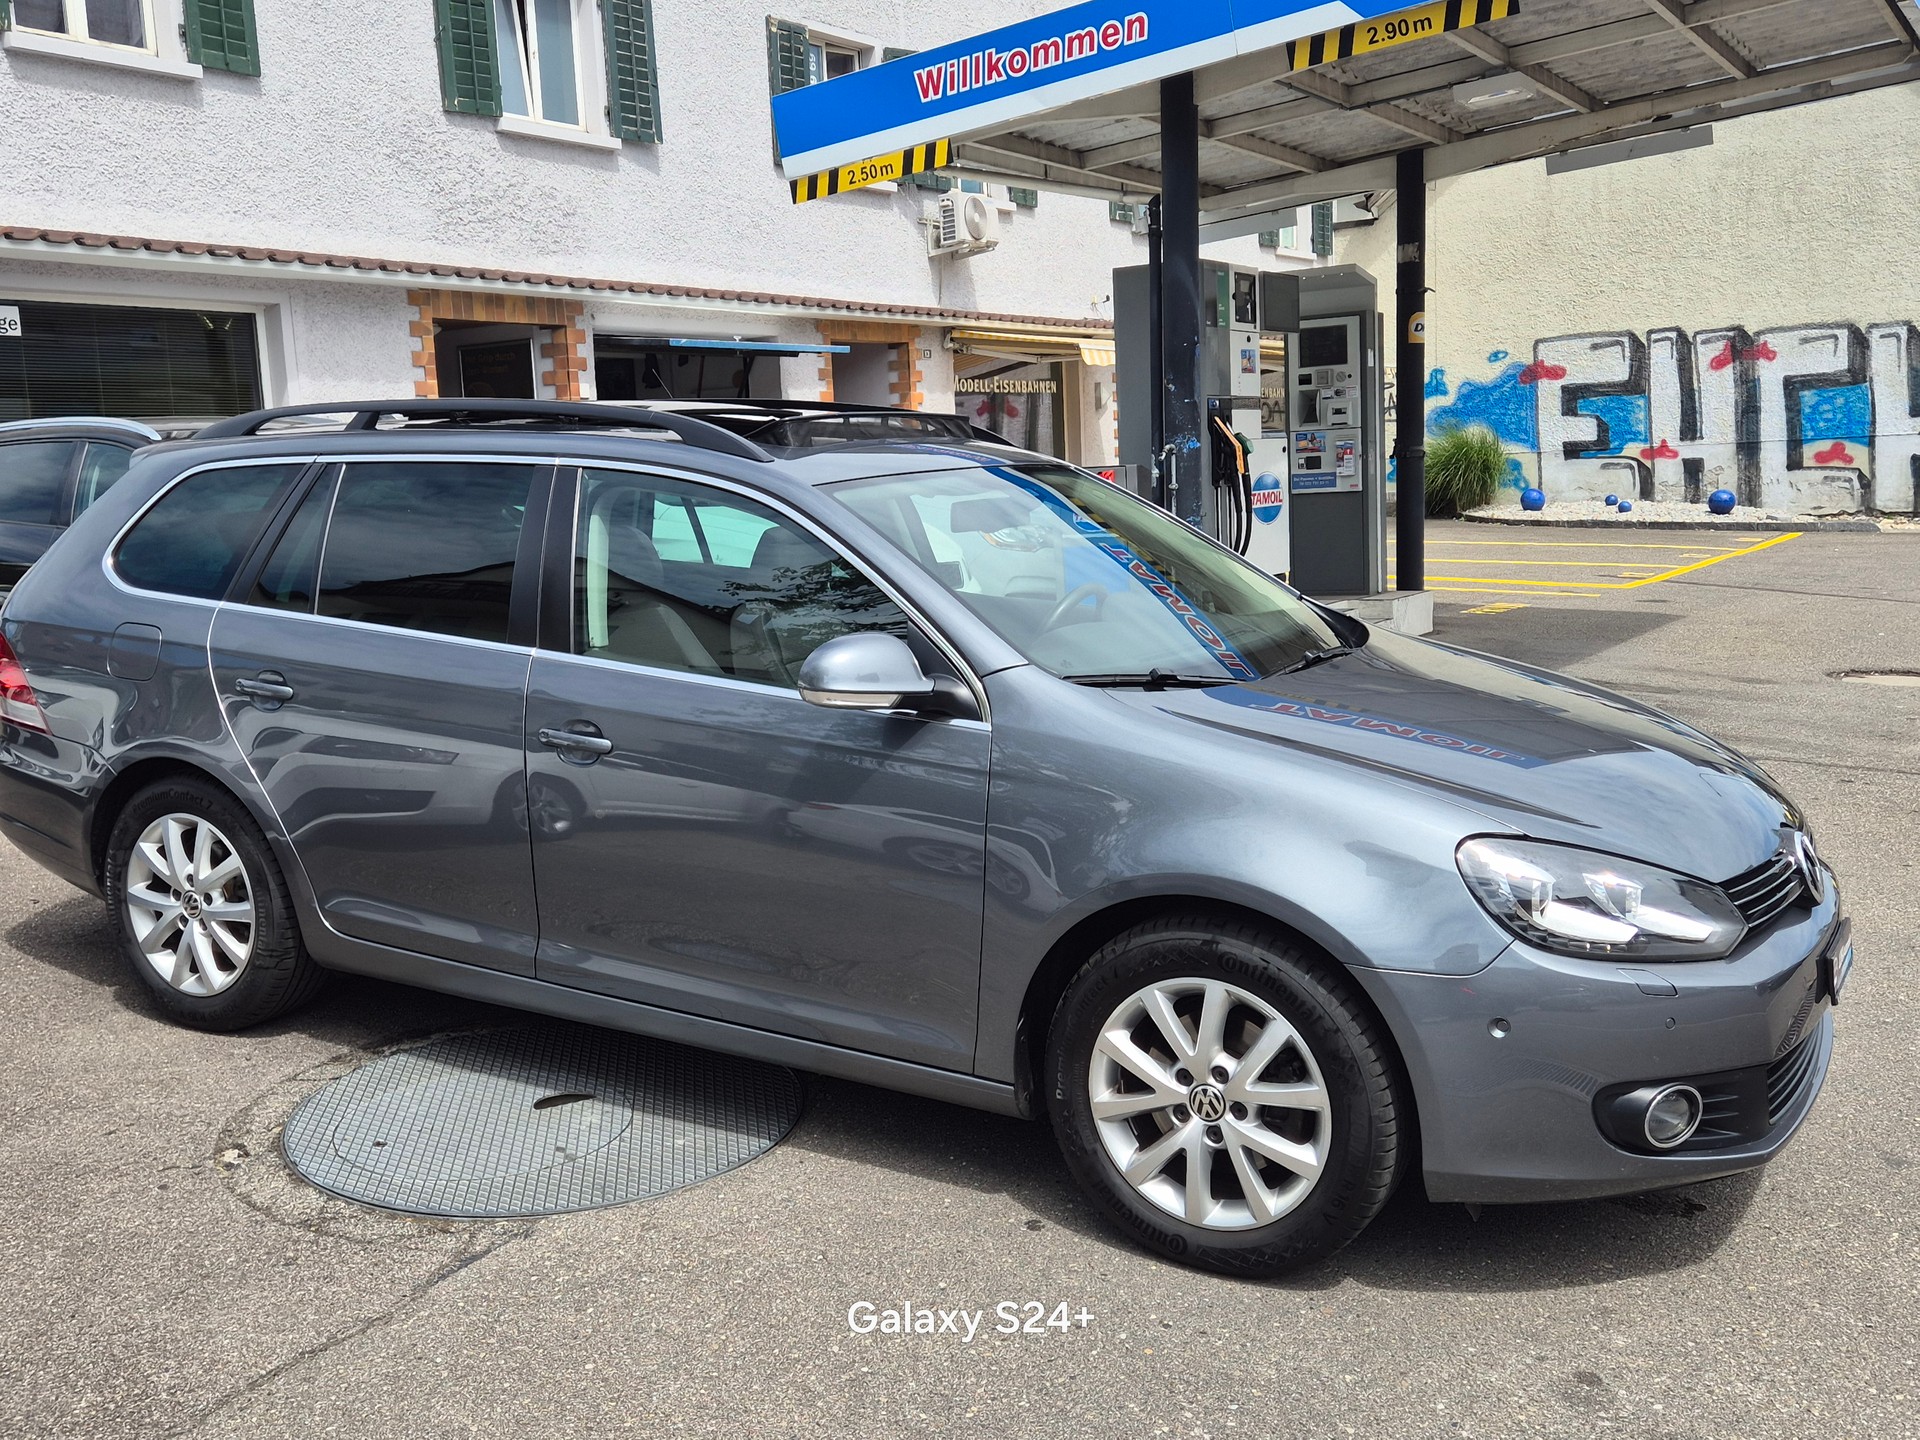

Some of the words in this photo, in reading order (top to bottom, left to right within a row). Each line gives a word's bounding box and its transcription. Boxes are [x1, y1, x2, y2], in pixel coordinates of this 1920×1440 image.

[914, 11, 1149, 103] Willkommen
[1251, 491, 1283, 505] TAMOIL
[1218, 951, 1322, 1024] Continental
